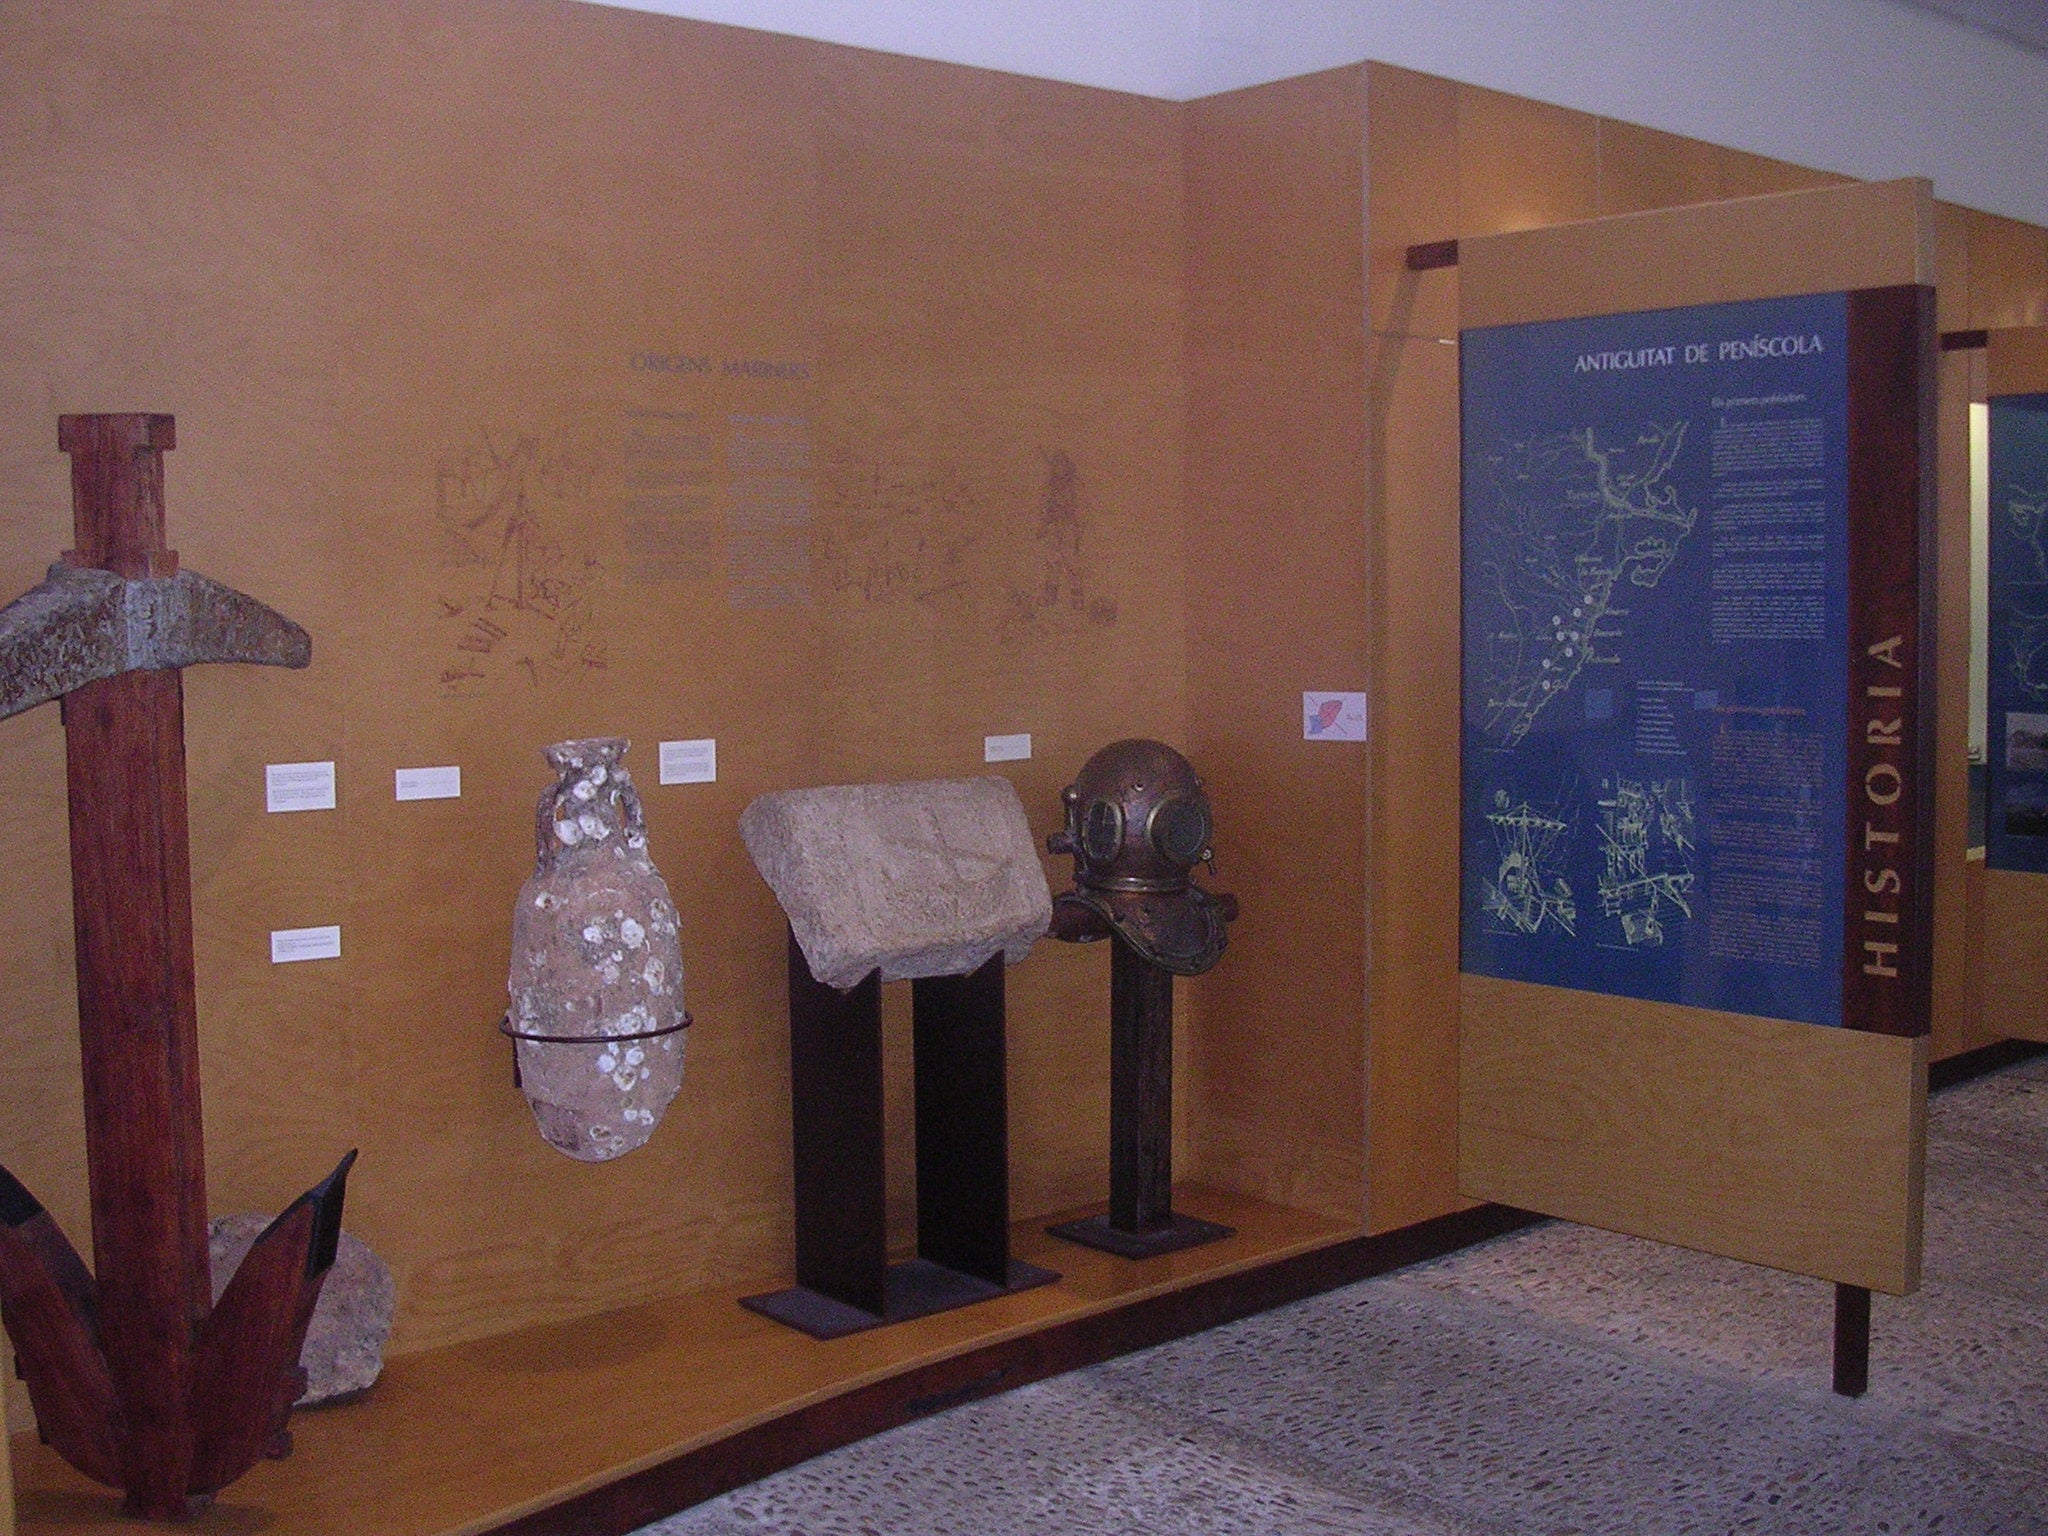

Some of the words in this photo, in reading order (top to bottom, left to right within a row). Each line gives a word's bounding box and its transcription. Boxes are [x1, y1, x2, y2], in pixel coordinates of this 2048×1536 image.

[1574, 346, 1676, 373] ANTIGUITAT
[1685, 343, 1709, 364] DE
[1719, 334, 1823, 361] PENÍSCOLA
[1863, 635, 1903, 977] HISTORIA
